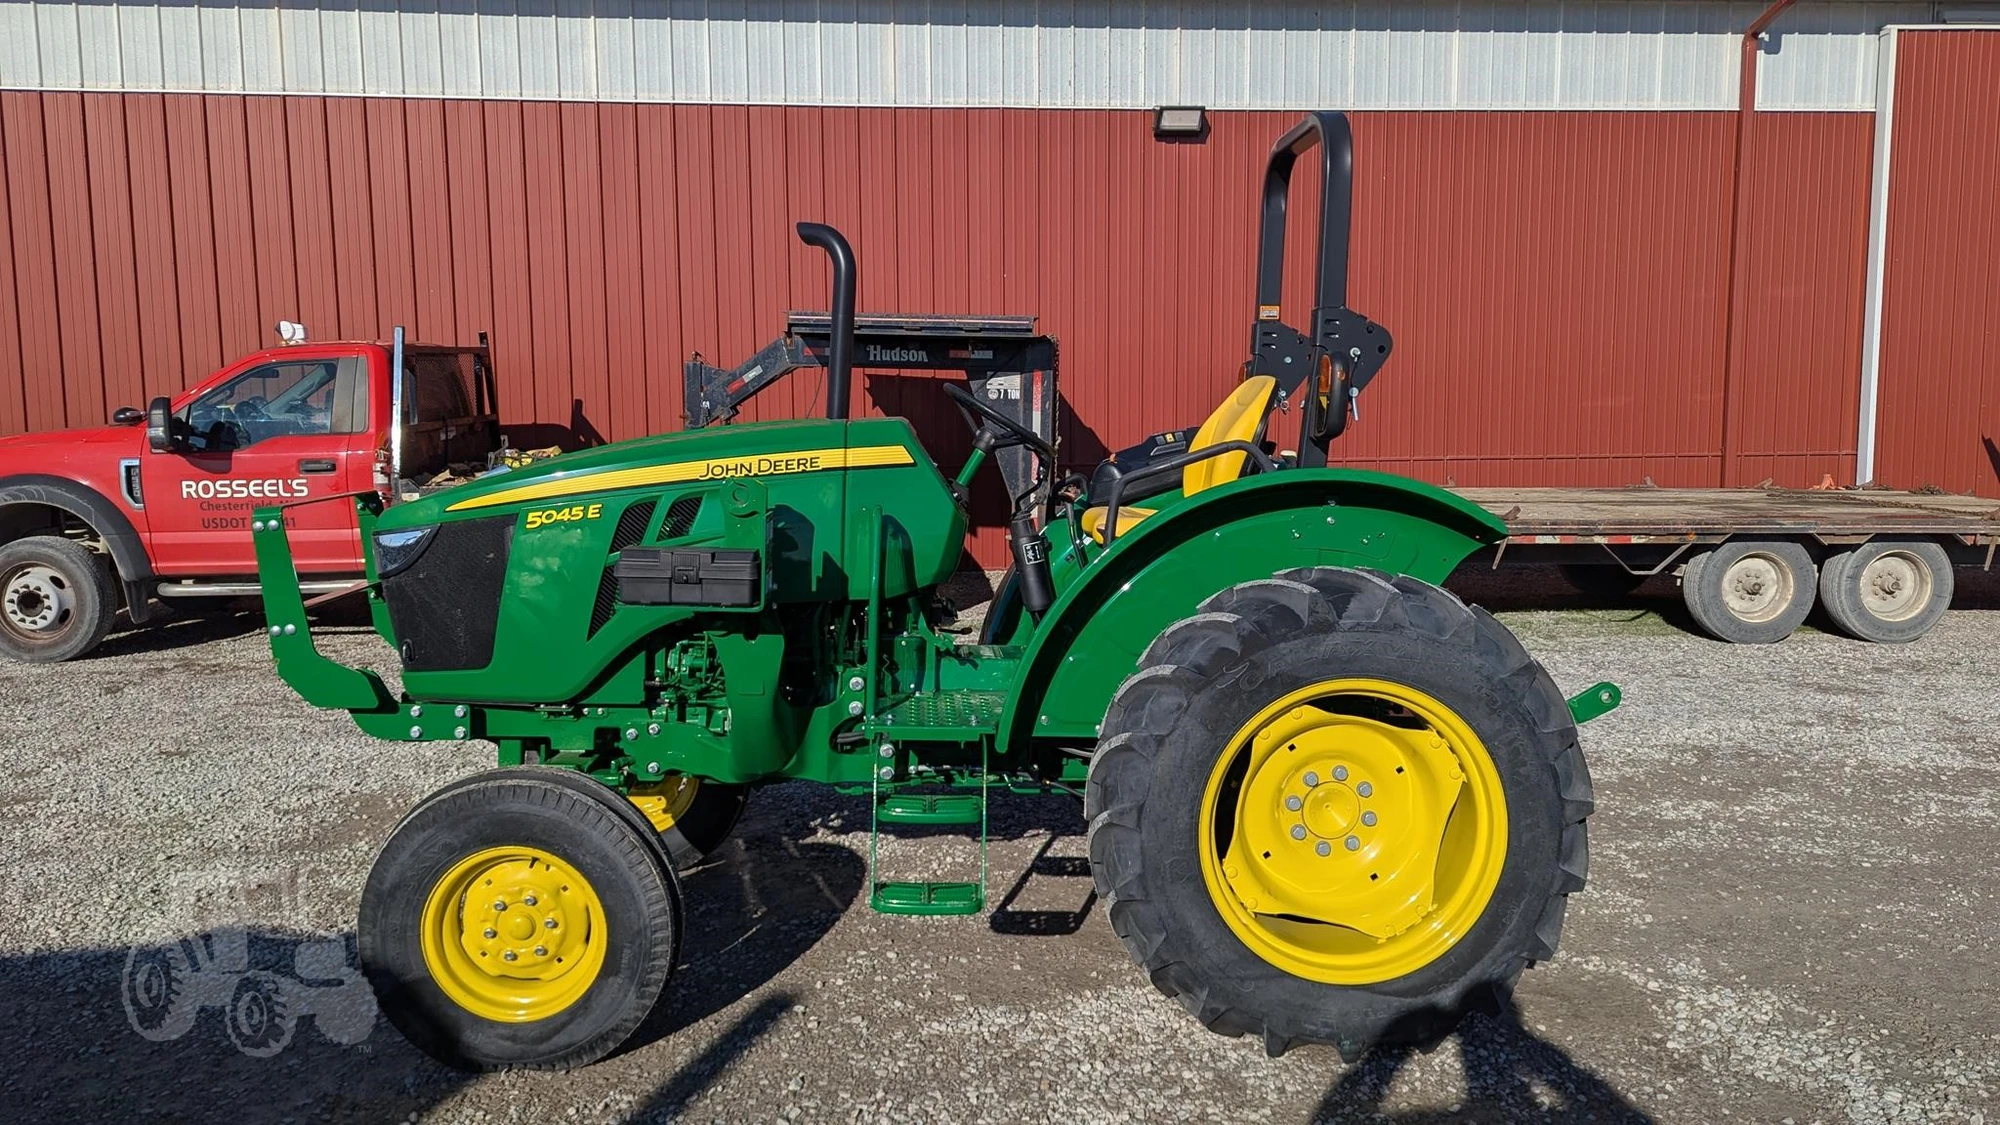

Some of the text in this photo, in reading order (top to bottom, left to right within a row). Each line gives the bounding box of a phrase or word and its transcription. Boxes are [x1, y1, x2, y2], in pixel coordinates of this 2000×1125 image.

[866, 344, 929, 362] Hudson
[1000, 389, 1004, 399] 7
[1008, 389, 1021, 400] TON
[699, 456, 821, 478] JOHN DEERE
[181, 479, 309, 499] ROSSEEL'S
[202, 517, 248, 529] USDOT
[526, 503, 602, 529] 5045 E
